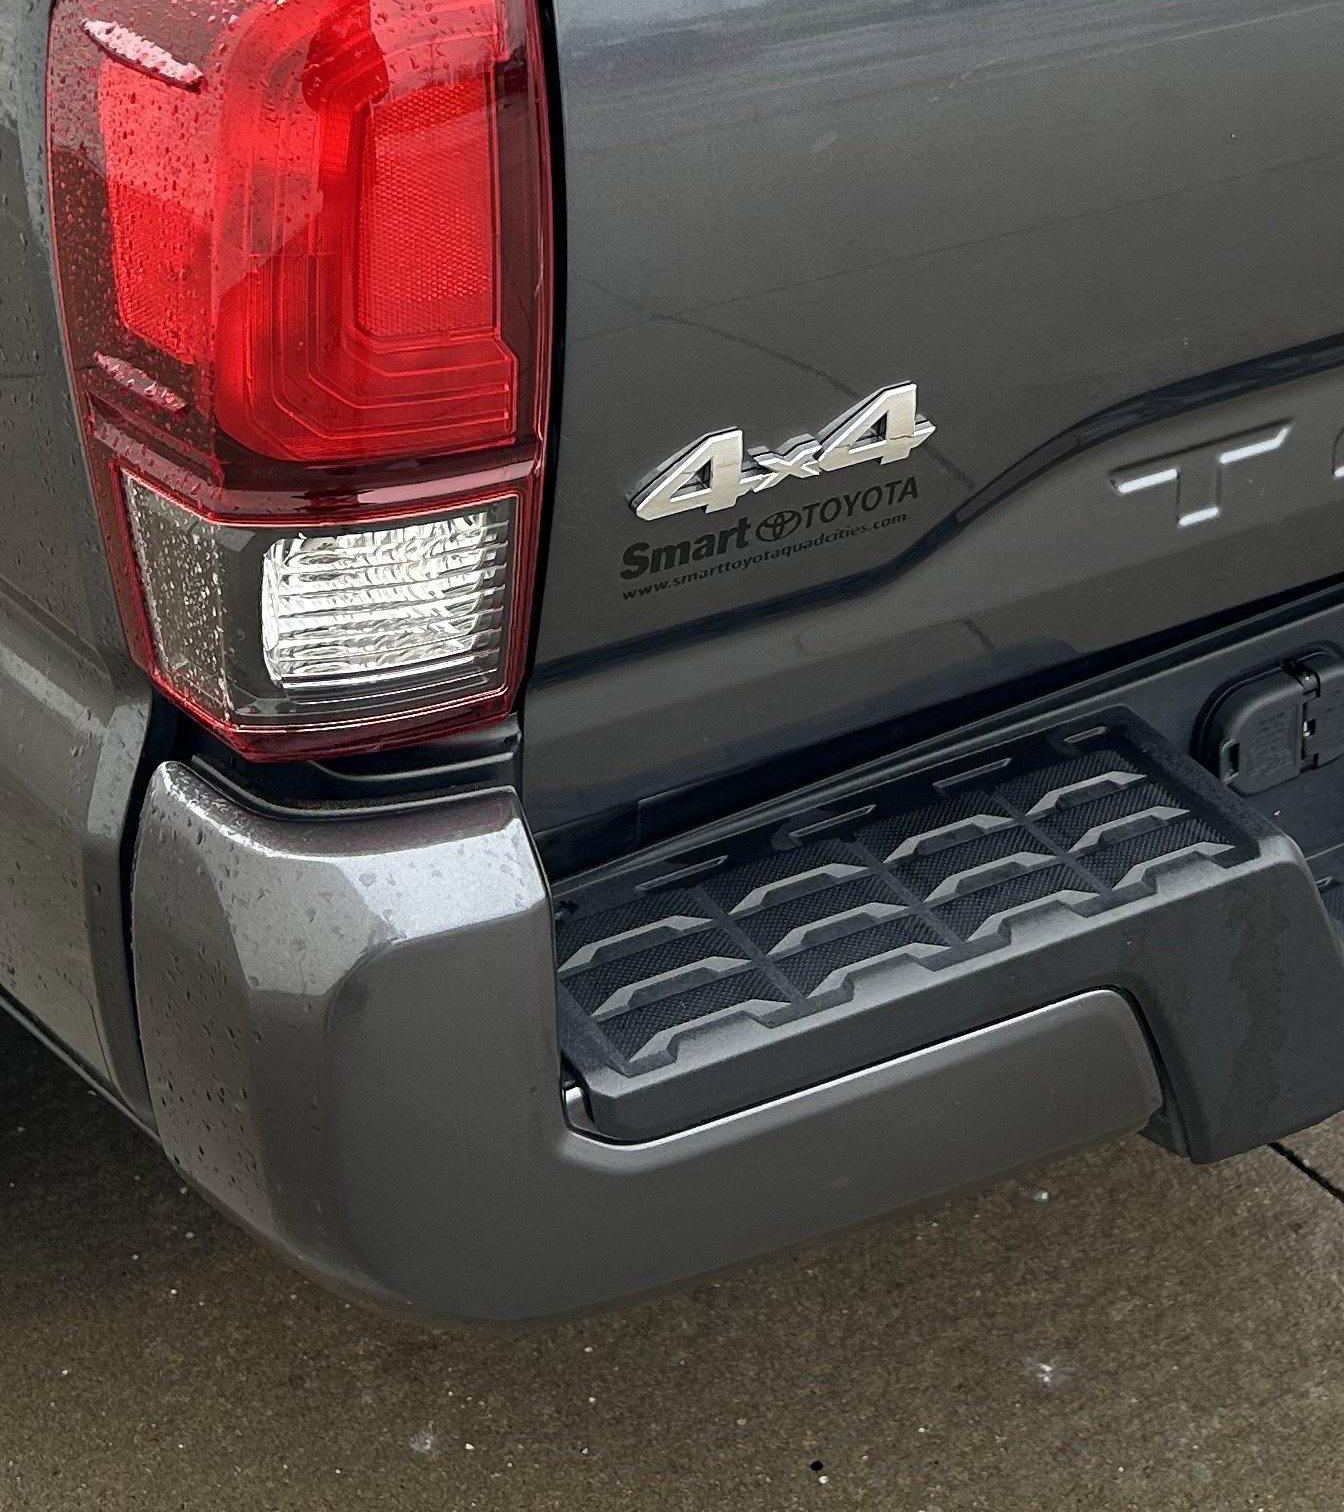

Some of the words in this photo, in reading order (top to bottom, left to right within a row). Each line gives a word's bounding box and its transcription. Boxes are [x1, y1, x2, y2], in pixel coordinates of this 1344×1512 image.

[619, 515, 751, 580] Smart
[804, 475, 919, 530] TOYOTA
[621, 510, 907, 600] www.smarttoyotaquadcities.com
